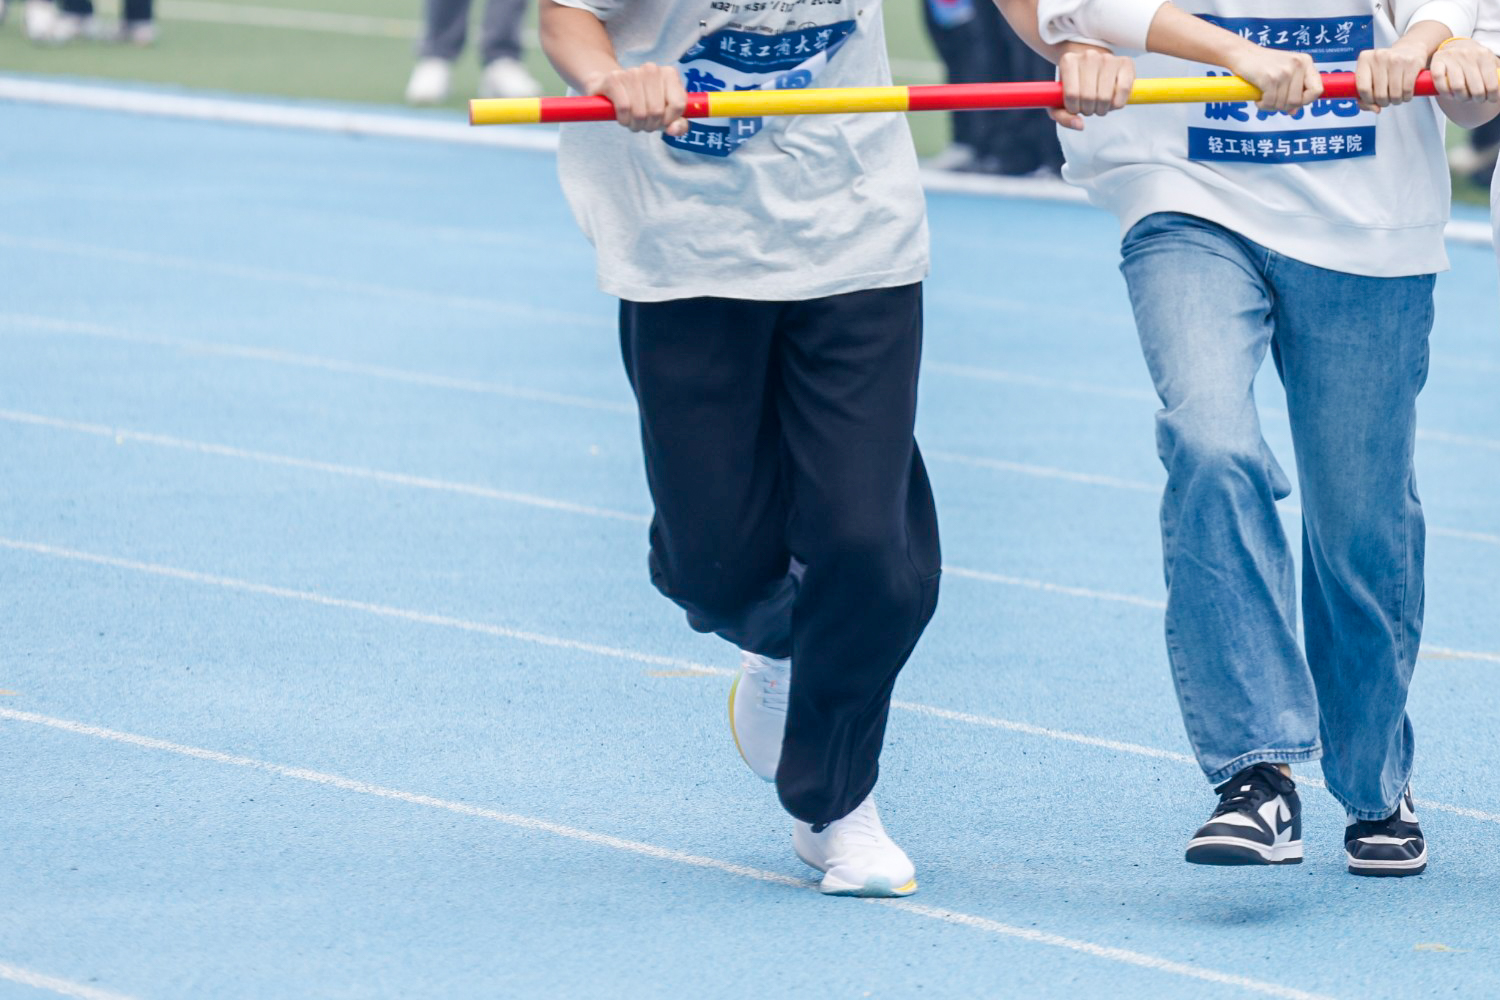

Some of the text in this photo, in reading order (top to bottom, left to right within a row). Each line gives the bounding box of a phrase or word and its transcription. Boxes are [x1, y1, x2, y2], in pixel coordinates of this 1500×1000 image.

[1208, 134, 1363, 157] 轻工科学与工程学院
